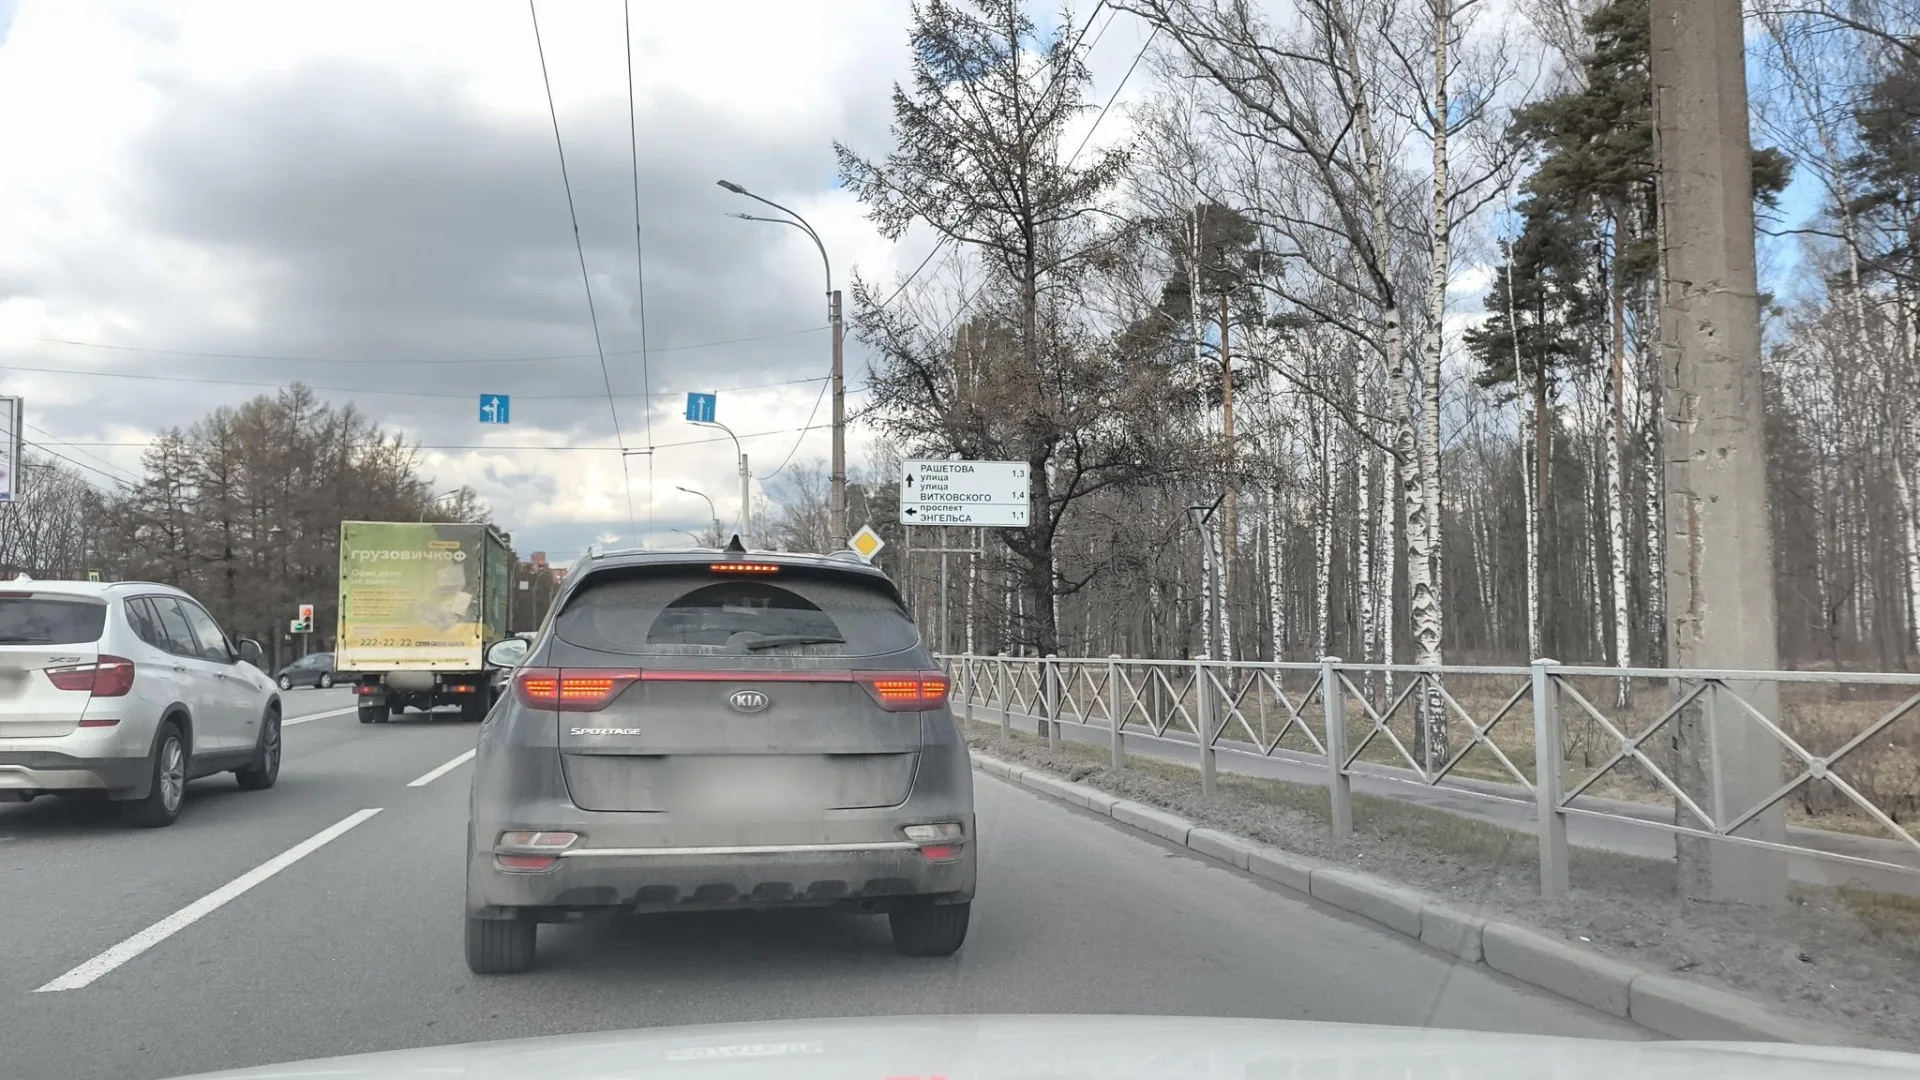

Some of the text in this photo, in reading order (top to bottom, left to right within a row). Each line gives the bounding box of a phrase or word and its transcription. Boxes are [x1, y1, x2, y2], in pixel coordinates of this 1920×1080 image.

[920, 464, 975, 473] РАШЕТОВА
[920, 474, 949, 482] улица
[1012, 470, 1024, 478] 1,3
[920, 493, 991, 502] ВИТКОВСКОГО
[1012, 492, 1024, 500] 1,4
[920, 514, 972, 522] ЭНГЕЛЬСА
[1012, 512, 1024, 520] 1,1
[360, 638, 412, 646] 222-22-22
[736, 694, 763, 707] KIA
